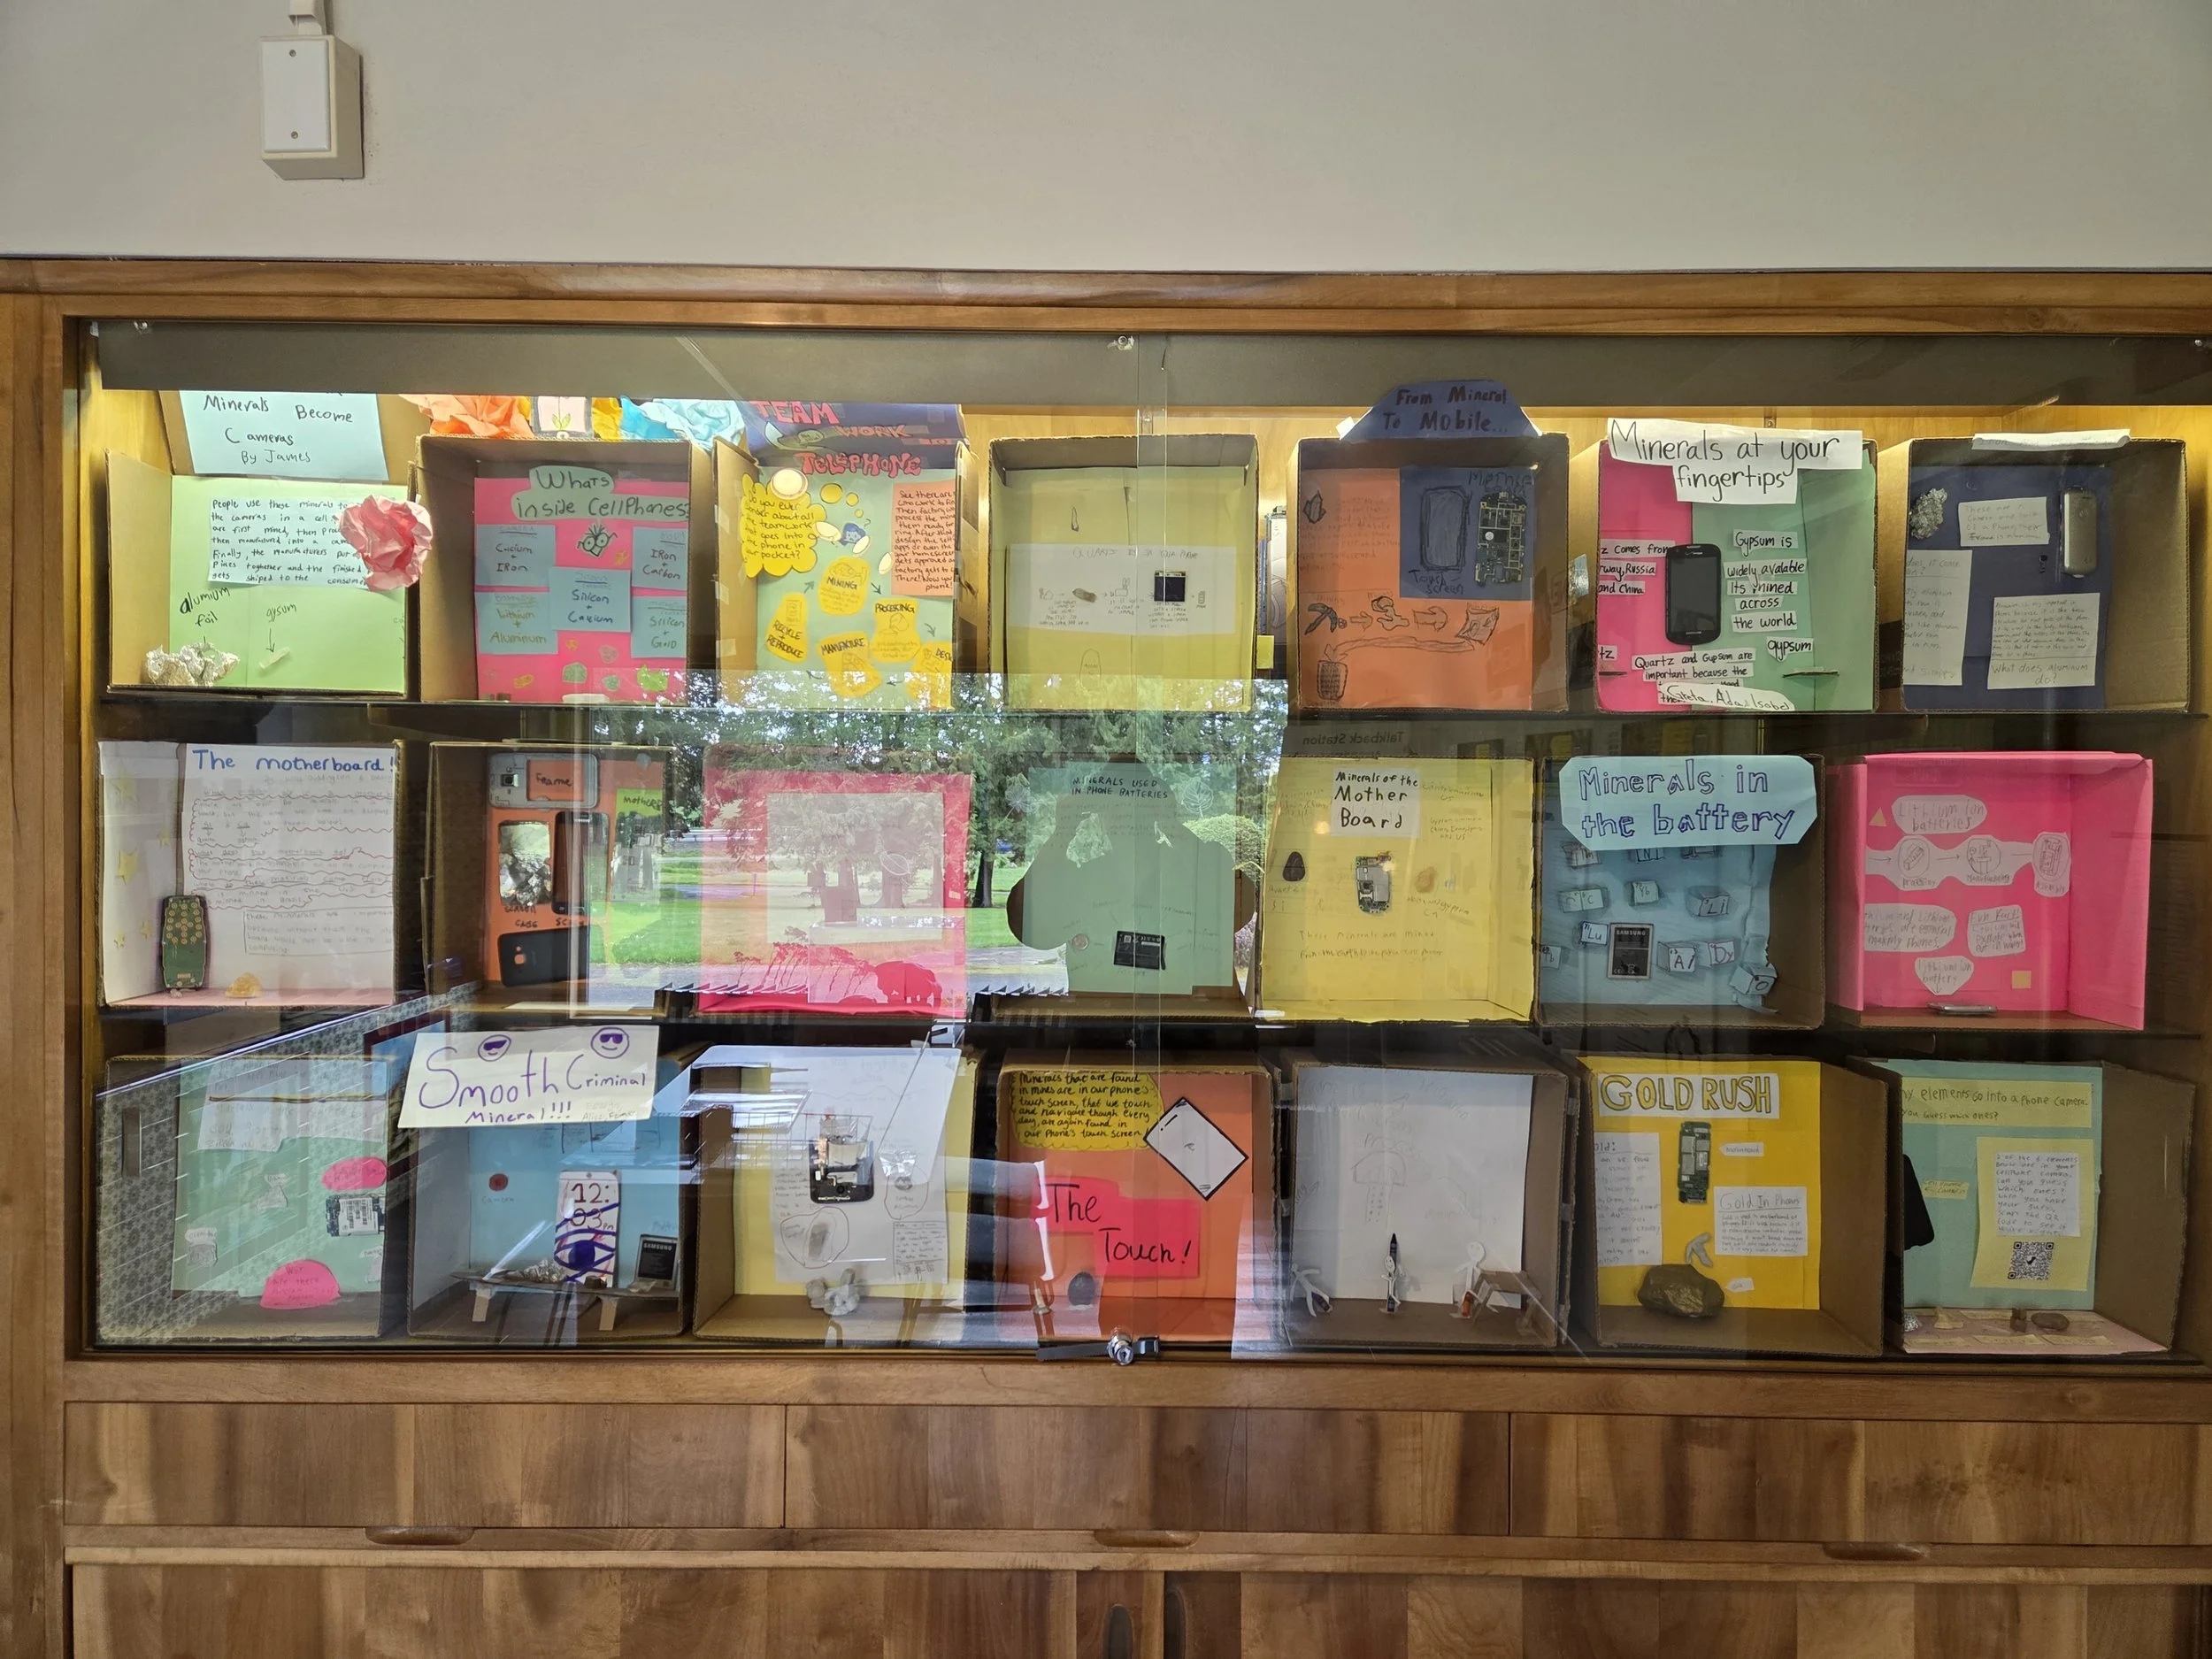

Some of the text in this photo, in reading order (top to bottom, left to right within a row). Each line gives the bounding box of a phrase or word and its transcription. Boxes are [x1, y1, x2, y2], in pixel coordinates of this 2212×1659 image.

[1396, 386, 1506, 405] From Mineral
[204, 396, 353, 424] Minerals Become
[749, 401, 840, 425] TEAM
[1382, 412, 1401, 430] To
[225, 427, 294, 446] Cameras
[833, 425, 912, 438] WORK
[1611, 419, 1839, 477] Minerals at your
[241, 449, 311, 464] By James
[793, 451, 922, 478] TELEPHONE
[1676, 465, 1785, 503] fingertips
[212, 499, 238, 510] People
[269, 499, 290, 510] these
[516, 497, 575, 518] inside
[779, 502, 800, 511] ever
[760, 519, 812, 530] teamwork
[1735, 534, 1792, 557] Gypsum is
[761, 550, 800, 559] pocket?
[914, 557, 946, 566] approved
[333, 565, 362, 573] finished
[642, 565, 680, 580] Carbon
[1625, 565, 1655, 574] Russia
[1727, 562, 1805, 588] widely avalable
[246, 574, 273, 583] shiped
[826, 576, 857, 590] MINING
[926, 581, 952, 592] phone!
[1598, 583, 1644, 595] and China
[1740, 597, 1779, 610] across
[195, 603, 297, 627] foil gysum
[1732, 613, 1796, 629] the world
[772, 619, 803, 640] RECYCLE
[766, 634, 803, 659] REPRODUCE
[1768, 638, 1812, 661] gypsum
[1634, 657, 1675, 669] Quartz
[1682, 653, 1697, 664] and
[1702, 651, 1733, 663] Gypsum
[1991, 663, 2015, 673] What
[2018, 662, 2043, 672] does
[1645, 666, 1748, 680] important because the
[2035, 672, 2057, 685] do?
[192, 749, 235, 770] The
[1072, 777, 1125, 787] MINERALS
[1335, 772, 1419, 787] Minerals of the
[1578, 758, 1769, 801] Minerals in
[1071, 786, 1169, 799] IN PHONE BATTERIES
[1333, 786, 1409, 802] Mother
[1340, 807, 1402, 828] Board
[1581, 803, 1795, 840] the battery
[419, 1046, 646, 1109] Smooth Criminal
[1019, 1073, 1062, 1084] Minerals
[1064, 1074, 1089, 1084] that
[1110, 1073, 1141, 1083] found
[1601, 1074, 1772, 1114] GOLD RUSH
[1921, 1087, 1970, 1102] elements
[1986, 1087, 2007, 1102] into
[1019, 1097, 1150, 1108] touch that touch
[465, 1102, 572, 1124] Mineral!!!
[1041, 1108, 1086, 1118] navigate
[1088, 1107, 1118, 1120] though
[1123, 1109, 1149, 1122] every
[1972, 1111, 1999, 1120] ones?
[1056, 1119, 1083, 1129] again
[1045, 1183, 1102, 1223] The
[1720, 1193, 1754, 1210] Gold
[1757, 1195, 1770, 1208] In
[643, 1242, 672, 1251] SAMSUNG
[1098, 1227, 1192, 1264] Touch!
